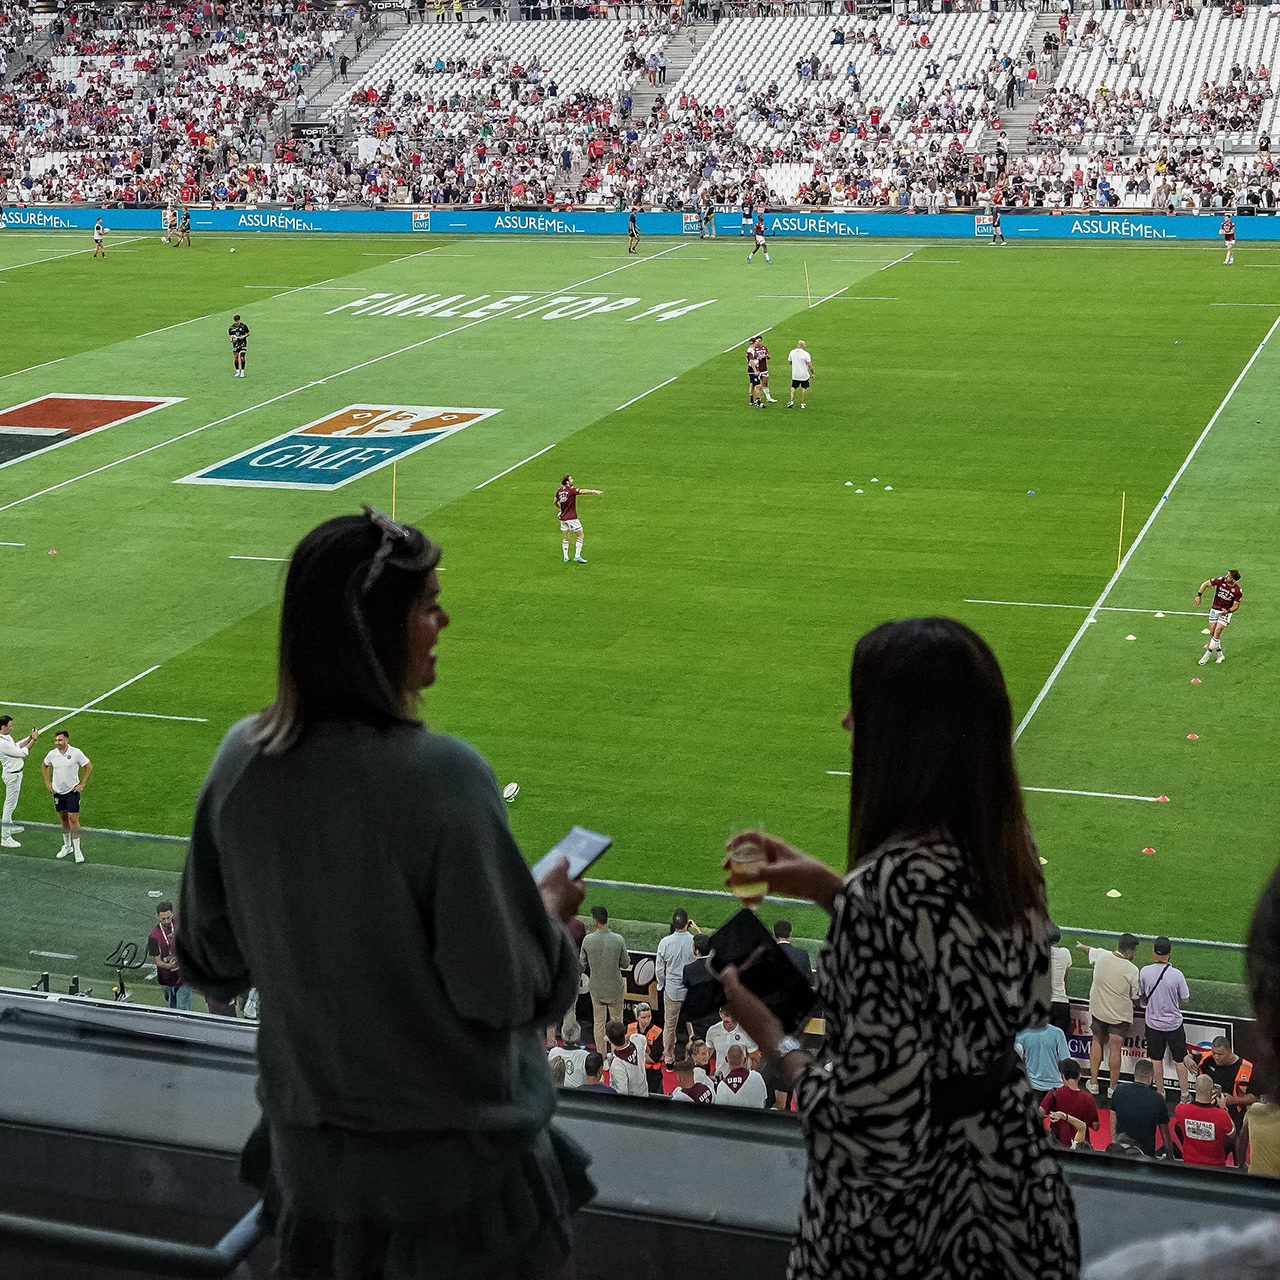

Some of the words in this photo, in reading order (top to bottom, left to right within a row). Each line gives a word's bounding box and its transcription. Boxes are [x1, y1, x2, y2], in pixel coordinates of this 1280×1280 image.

[413, 222, 429, 230] GMF
[323, 293, 532, 318] FINALE
[512, 296, 641, 320] TOP
[625, 299, 718, 322] 14
[248, 444, 394, 473] GMF
[1069, 1038, 1091, 1054] GM
